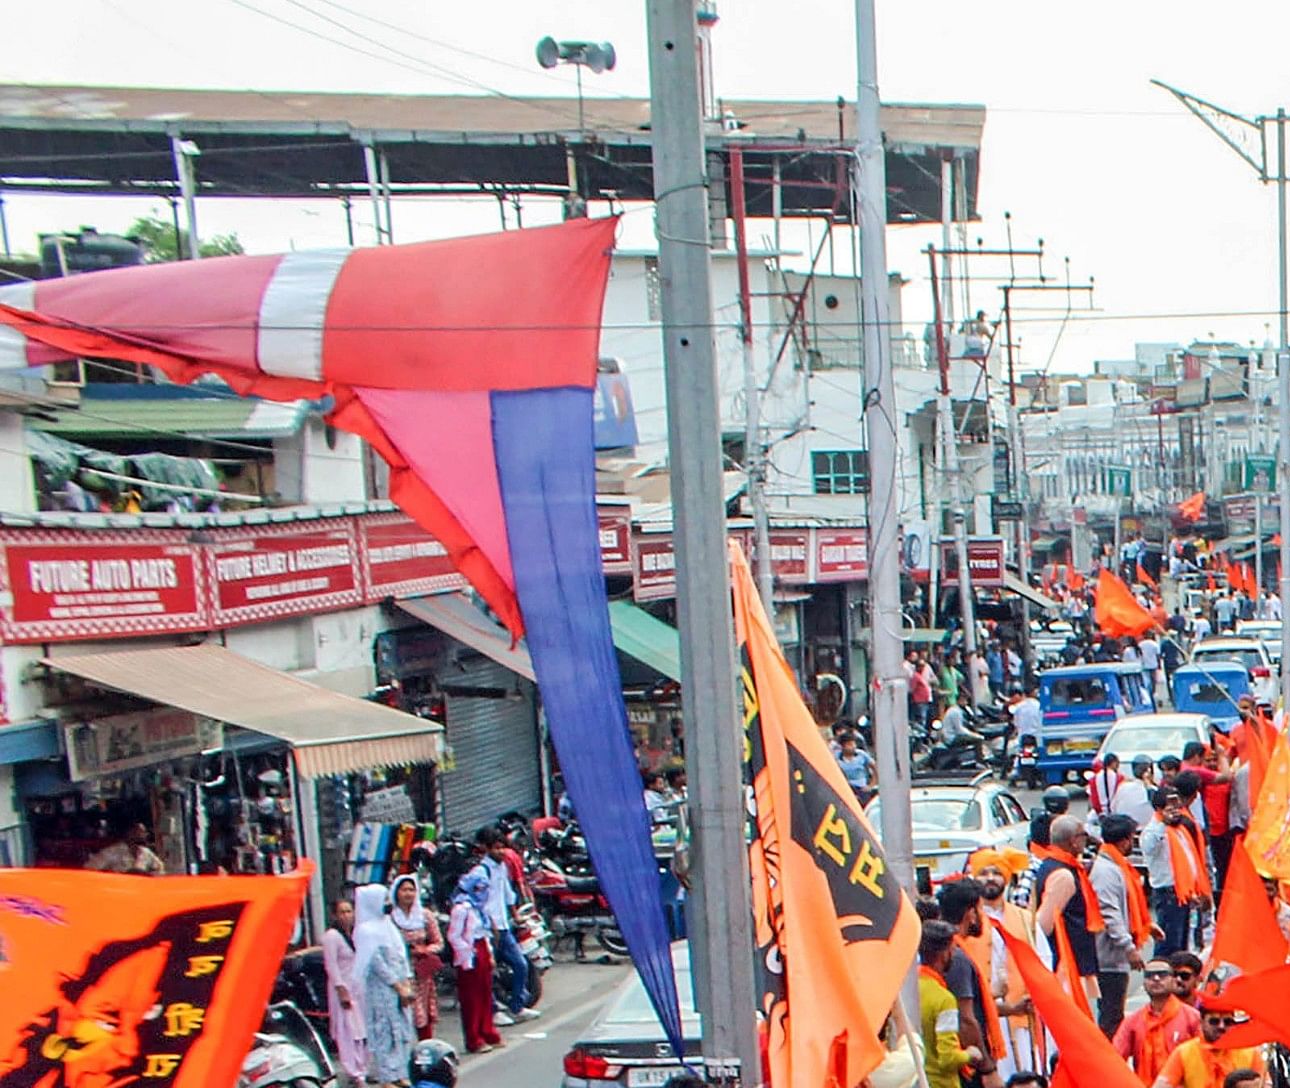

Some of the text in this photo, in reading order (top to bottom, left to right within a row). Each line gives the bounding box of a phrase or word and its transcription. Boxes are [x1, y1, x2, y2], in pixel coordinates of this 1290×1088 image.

[29, 558, 178, 593] FUTURE AUTO PARTS
